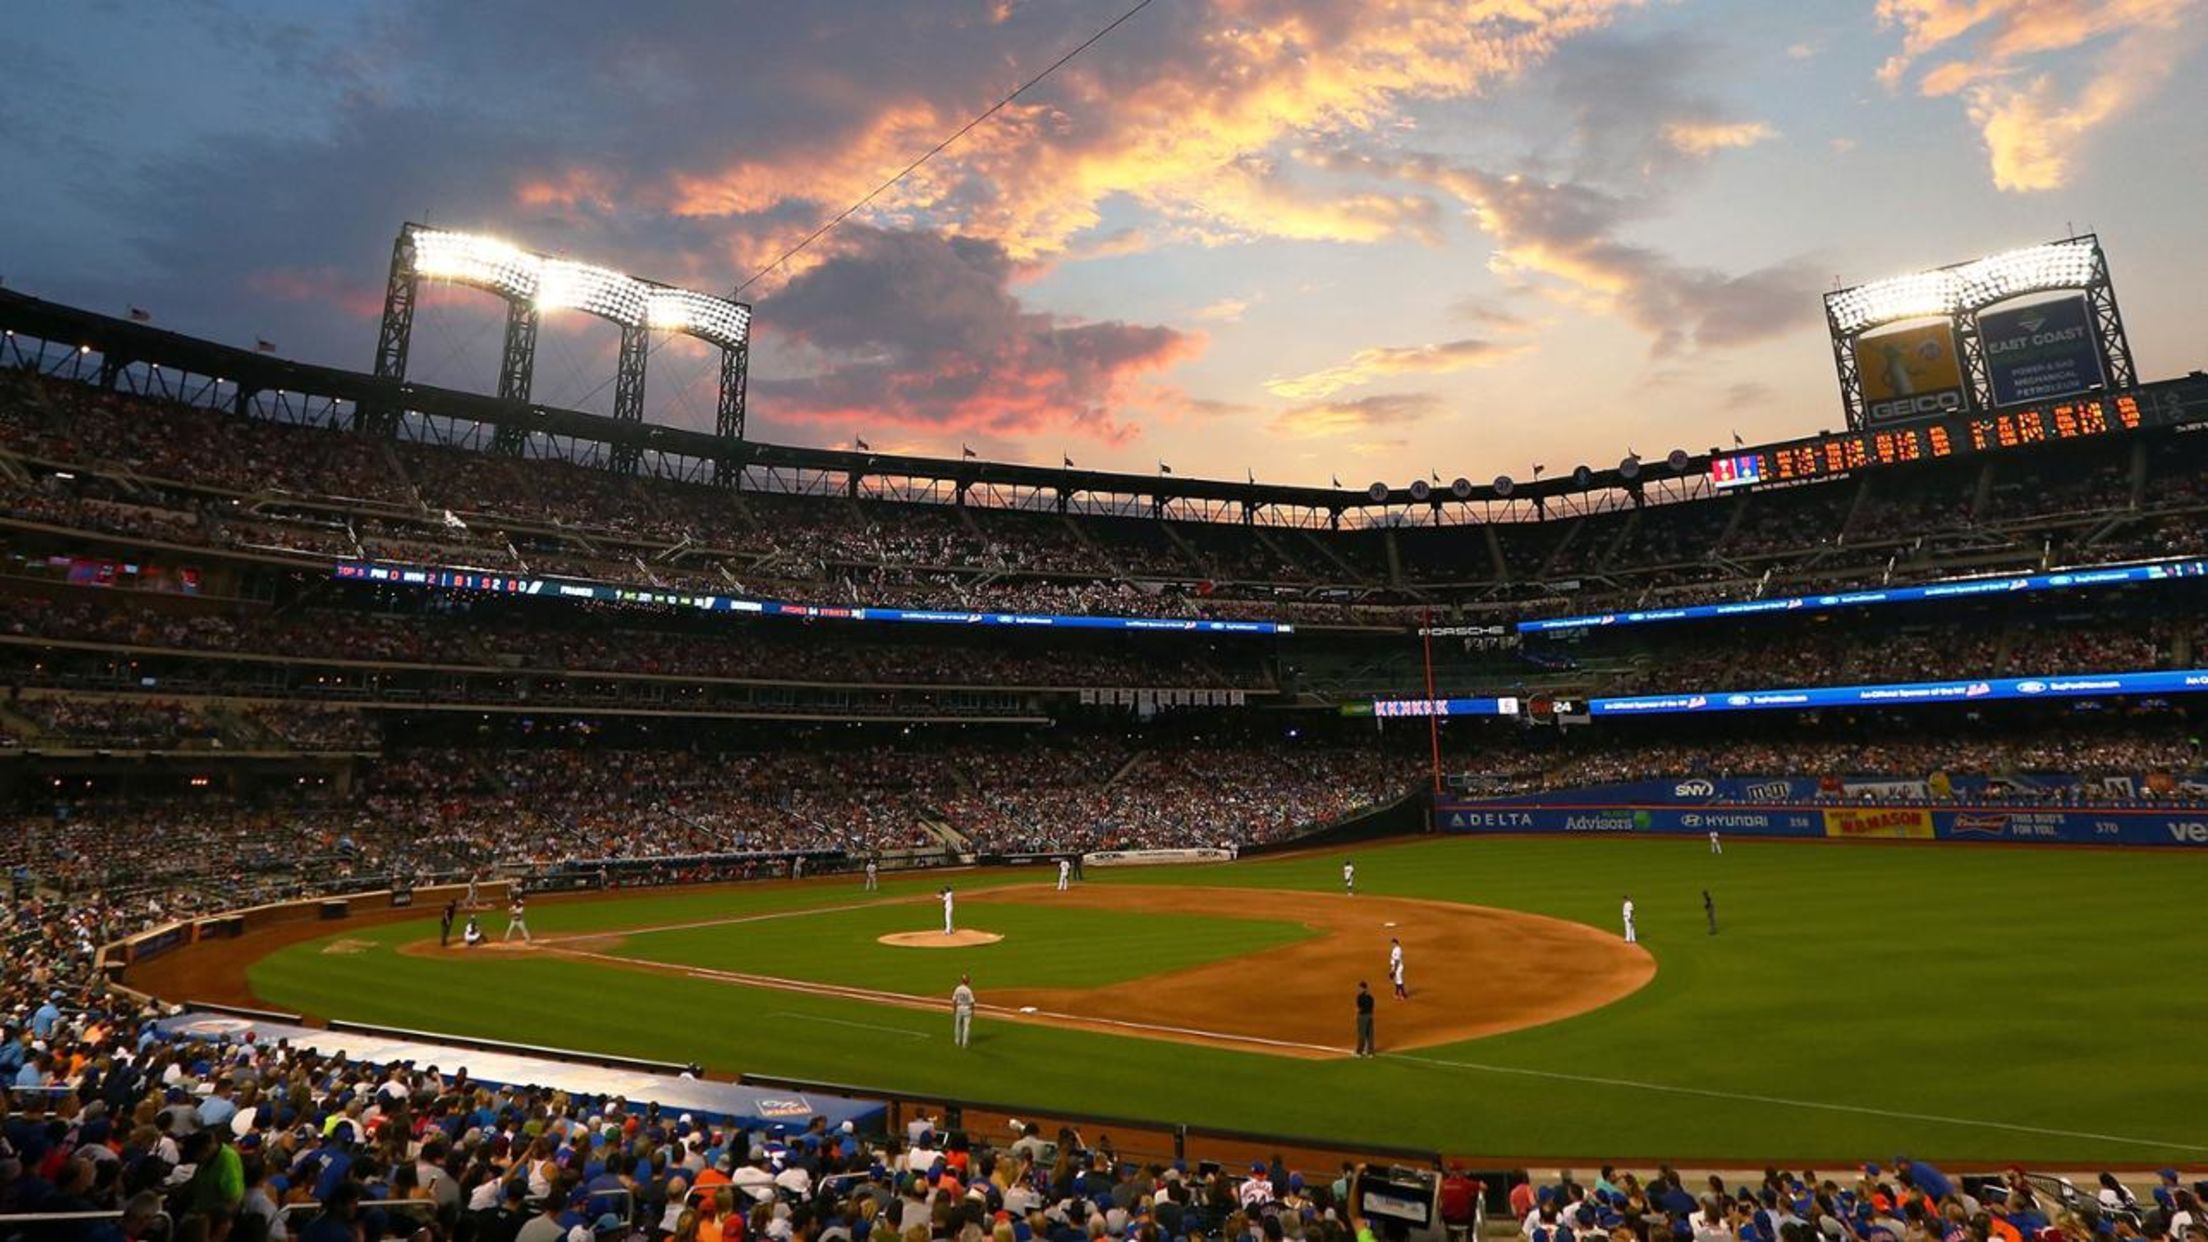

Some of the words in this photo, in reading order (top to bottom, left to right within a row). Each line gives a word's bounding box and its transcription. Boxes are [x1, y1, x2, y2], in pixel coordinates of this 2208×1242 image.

[1988, 336, 2027, 354] EAST
[2033, 325, 2084, 347] COAST
[1871, 391, 1960, 419] GEICO
[427, 573, 436, 584] 2
[491, 578, 501, 590] 2
[1418, 626, 1505, 637] PORSCHE
[1675, 783, 1710, 797] SNY
[1470, 813, 1533, 827] DELTA
[1565, 816, 1633, 831] Advisors
[1706, 815, 1769, 827] HYUNDAI
[2012, 825, 2032, 836] FOR
